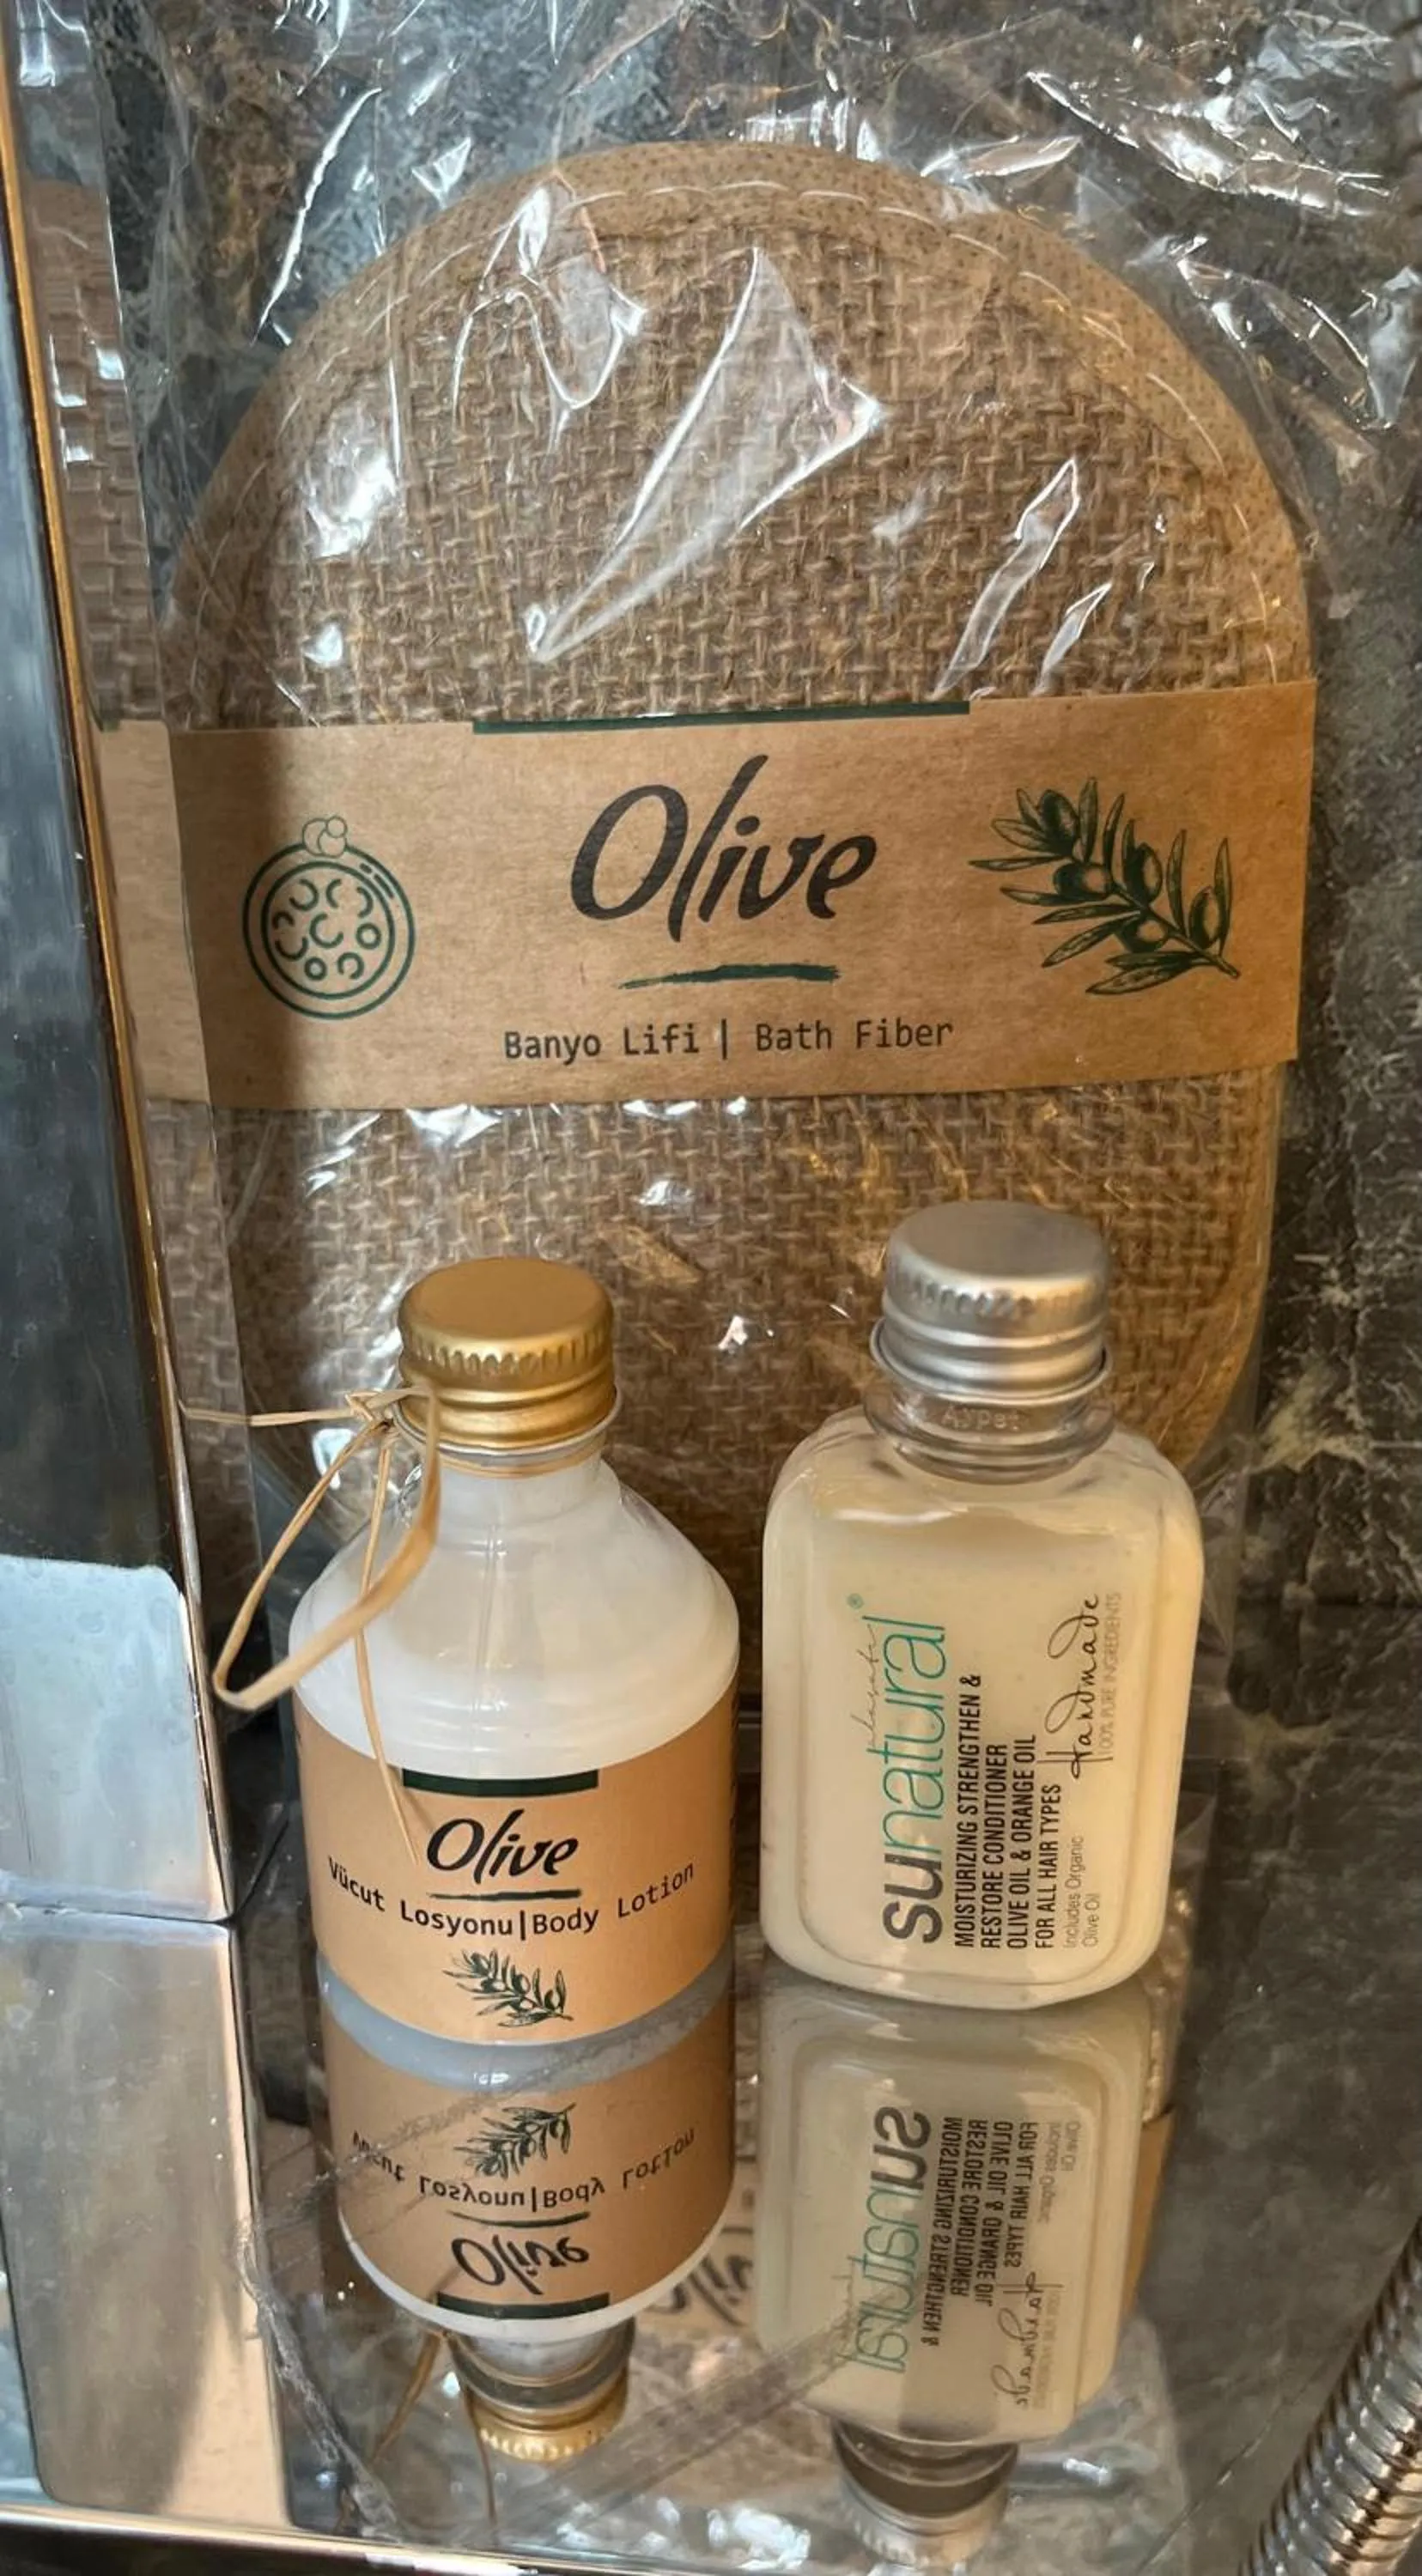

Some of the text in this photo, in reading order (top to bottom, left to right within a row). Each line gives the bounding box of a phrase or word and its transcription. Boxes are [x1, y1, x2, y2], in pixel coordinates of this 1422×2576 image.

[570, 754, 878, 943] Olive
[503, 1030, 602, 1066] Banyo
[623, 1022, 700, 1056] Lifi
[756, 1022, 833, 1052] Bath
[855, 1018, 953, 1048] Fiber
[1036, 1594, 1114, 1780] Handmade
[426, 1807, 579, 1884] Olive
[862, 1614, 946, 1944] sunatural
[954, 1674, 981, 1947] MOISTURIZING STRENGTHEN &
[981, 1744, 1008, 1949] RESTORE CONDITIONER
[1006, 1734, 1036, 1949] OLIVE OIL & ORANGE OIL
[1036, 1783, 1061, 1949] FOR ALL HAIR TYPES
[328, 1856, 386, 1912] Vücut
[617, 1860, 695, 1918] Lotion
[1062, 1835, 1085, 1948] Includes Organic
[1082, 1910, 1100, 1948] Olive
